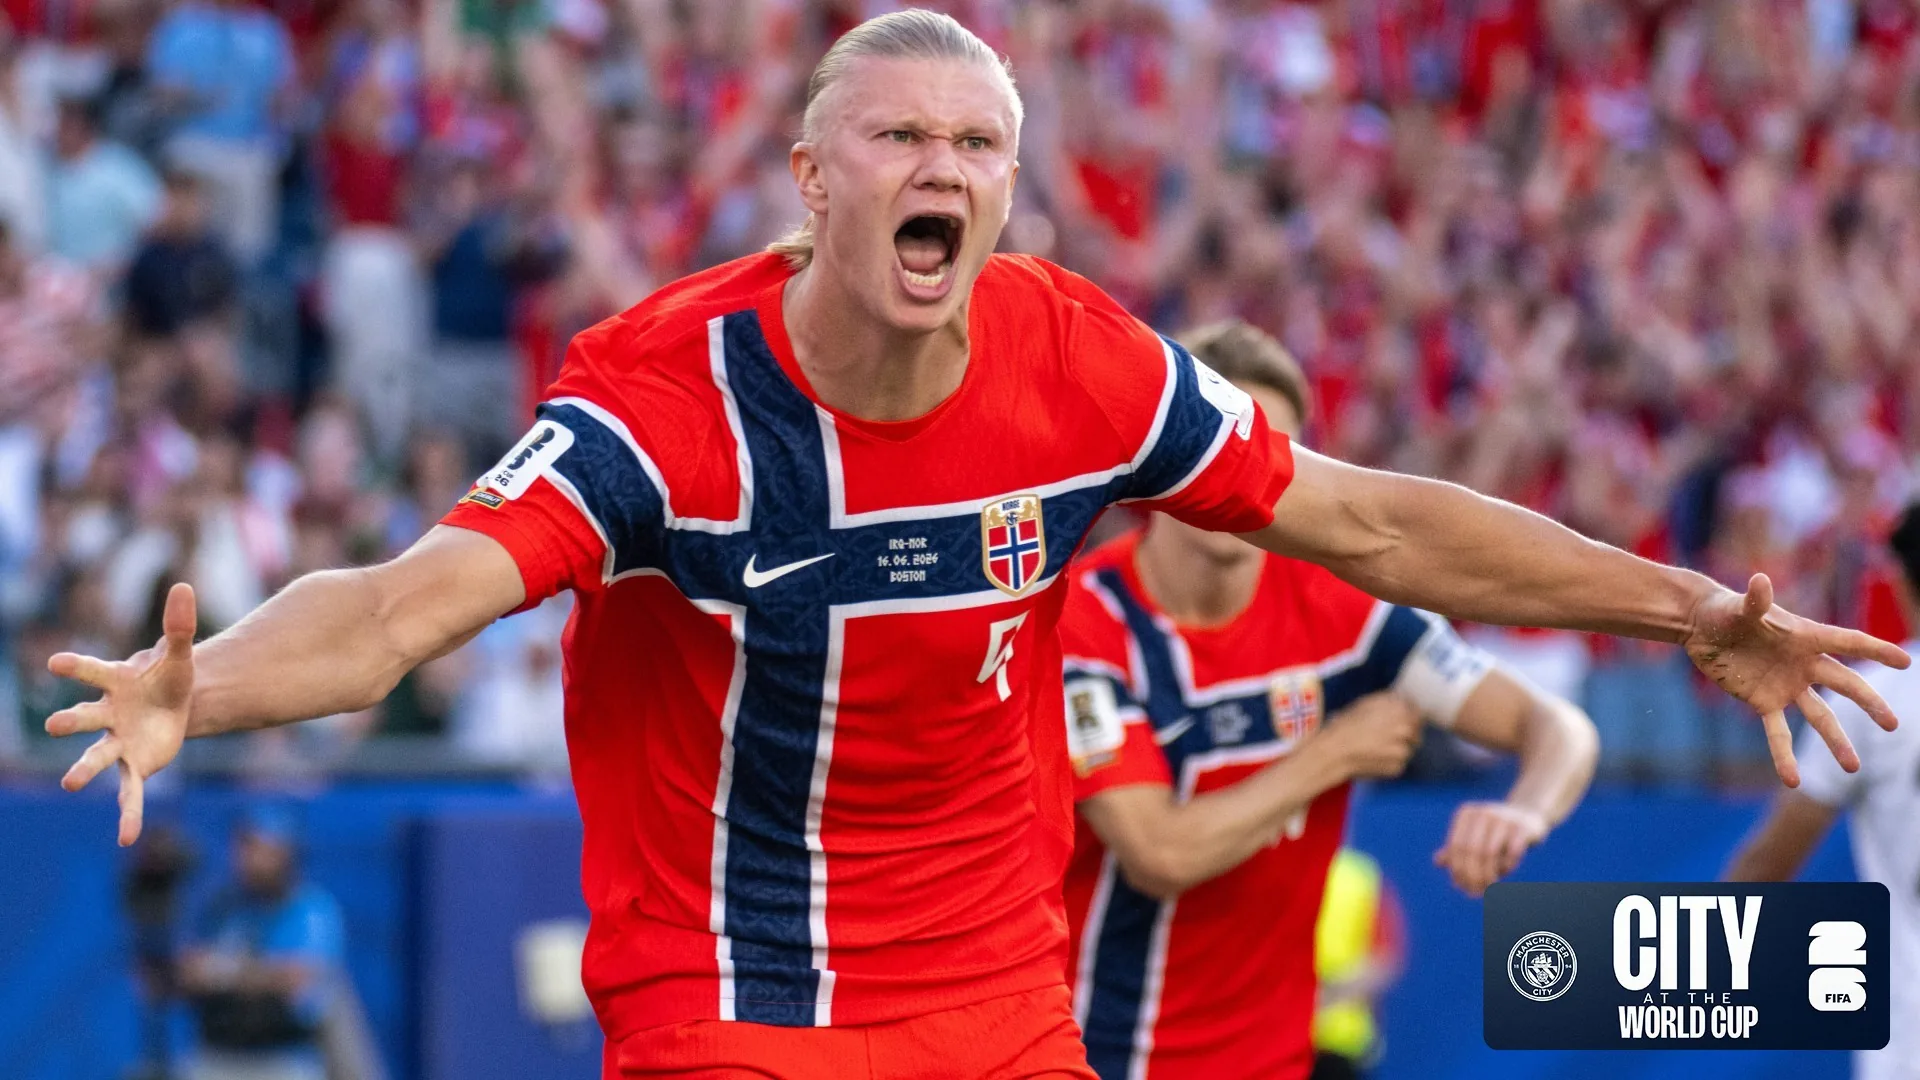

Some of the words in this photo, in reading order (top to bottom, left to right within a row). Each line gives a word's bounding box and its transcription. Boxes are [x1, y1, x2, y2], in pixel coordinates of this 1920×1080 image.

[494, 474, 509, 486] 26
[1002, 499, 1020, 511] NORGE
[889, 537, 928, 550] IRQ-NOR
[890, 570, 926, 583] BOSTON
[976, 609, 1031, 702] 9
